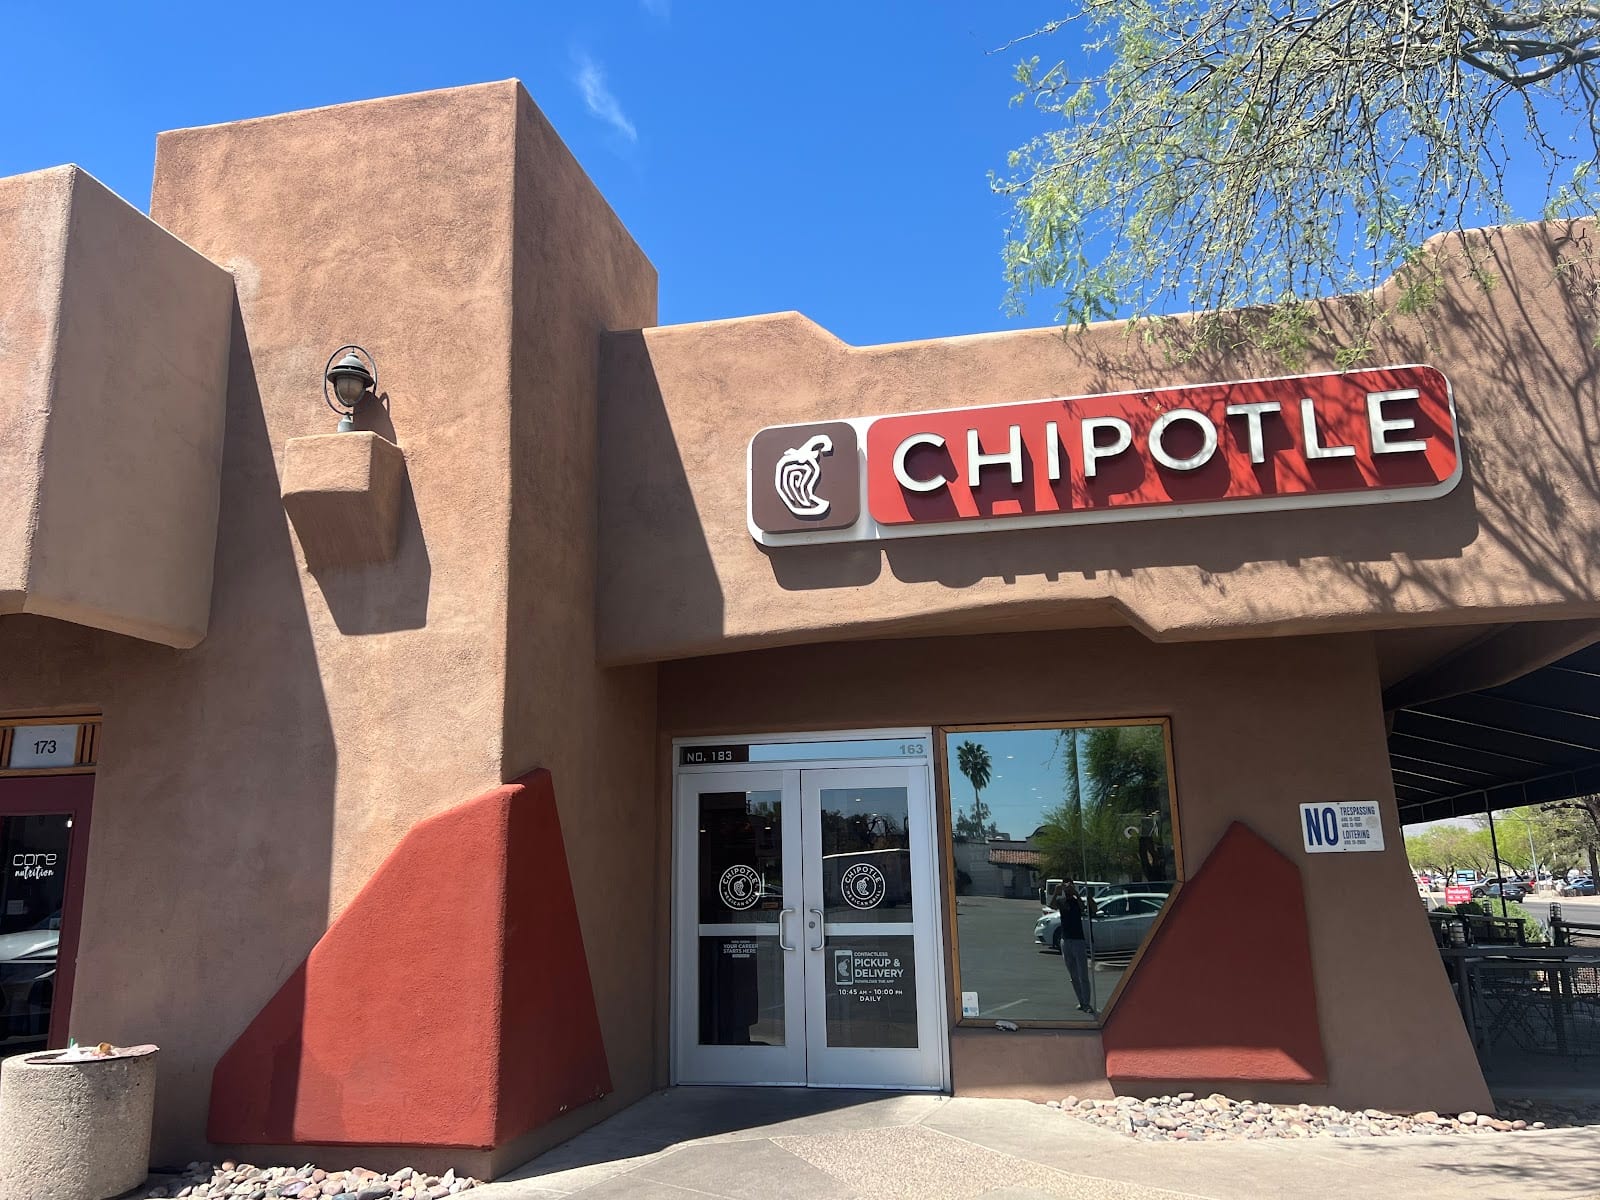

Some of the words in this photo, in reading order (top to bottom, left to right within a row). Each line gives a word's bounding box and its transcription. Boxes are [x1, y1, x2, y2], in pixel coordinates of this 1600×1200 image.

[892, 388, 1427, 492] CHIPOTLE
[34, 740, 57, 754] 173
[900, 744, 923, 754] 163
[687, 752, 706, 762] NO.
[1340, 806, 1375, 816] TRESPASSING
[1305, 807, 1339, 846] NO
[1342, 830, 1370, 839] LOITERING
[13, 853, 57, 866] core
[14, 865, 54, 880] nutrition
[722, 867, 758, 885] CHIPOTLE
[845, 866, 881, 884] CHIPOTLE
[854, 958, 891, 967] PICKUP
[893, 958, 901, 967] &
[855, 969, 904, 978] DELIVERY
